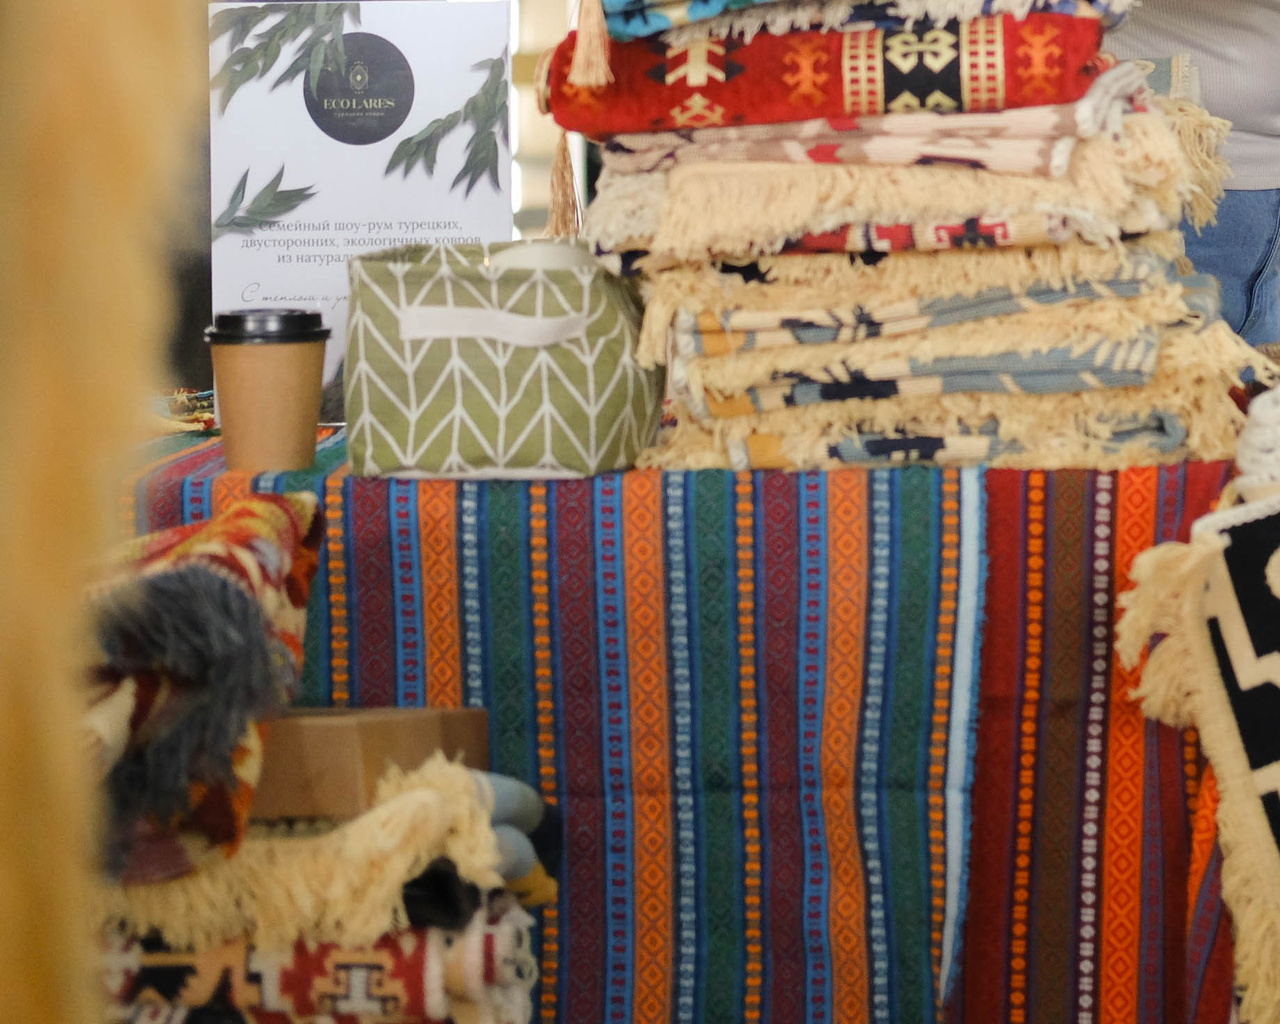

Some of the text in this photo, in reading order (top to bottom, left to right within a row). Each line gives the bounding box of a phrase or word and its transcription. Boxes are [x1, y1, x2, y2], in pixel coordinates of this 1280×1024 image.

[258, 219, 462, 234] Семейный шоу-рум турецких,
[240, 237, 339, 251] двусторонних,
[277, 253, 292, 263] из
